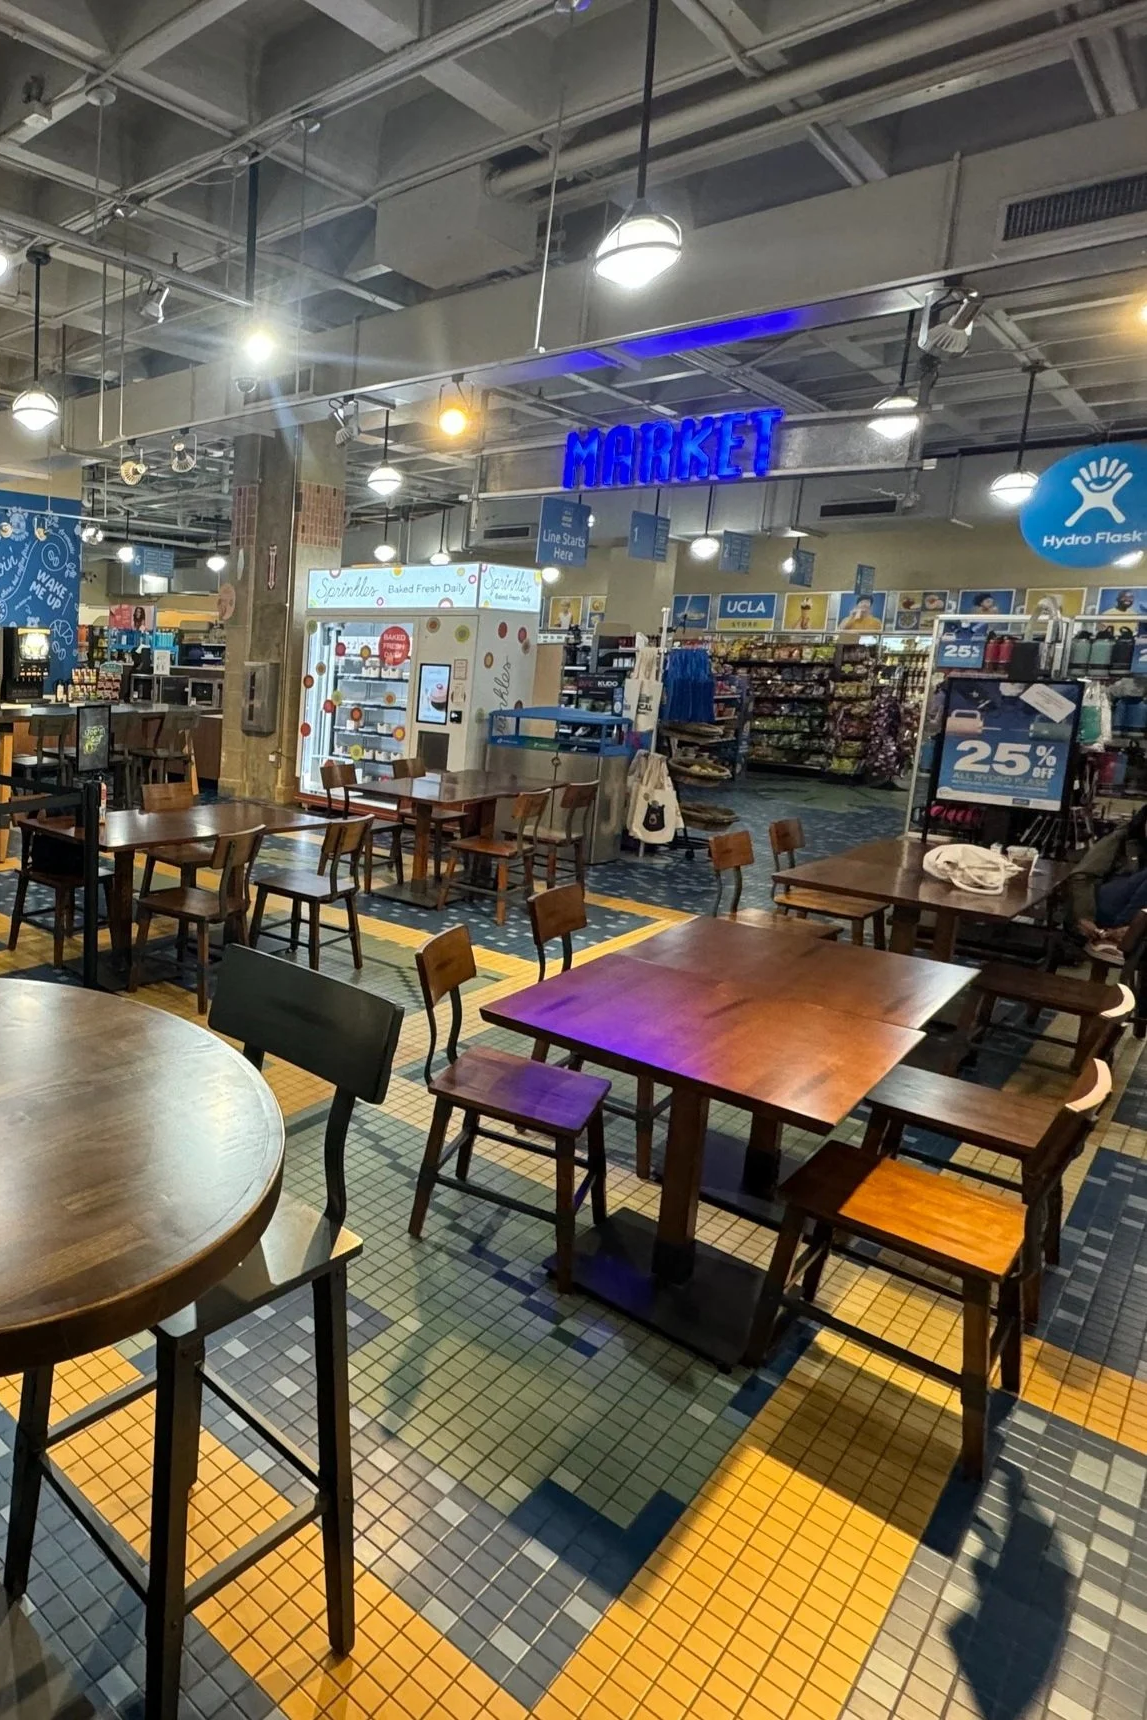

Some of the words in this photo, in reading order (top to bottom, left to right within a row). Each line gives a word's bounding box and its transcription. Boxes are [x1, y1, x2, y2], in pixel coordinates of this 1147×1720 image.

[562, 407, 785, 490] MARKET
[543, 529, 561, 543] Line
[562, 532, 586, 549] Starts
[1043, 533, 1092, 548] Hydro
[1095, 530, 1143, 545] Flask
[553, 547, 574, 561] Here
[36, 569, 69, 600] WAKE
[316, 576, 380, 604] Sprinkles
[388, 585, 414, 594] Baked
[416, 584, 441, 593] Fresh
[445, 583, 467, 595] Daily
[484, 566, 532, 596] Sprinkles
[29, 581, 45, 600] ME
[47, 592, 63, 611] UP
[727, 600, 767, 615] UCLA
[382, 642, 406, 650] FRESH
[383, 633, 406, 642] BAKED
[953, 772, 973, 780] ALL
[973, 774, 1011, 784] HYDRO
[1014, 777, 1048, 787] FLASK
[1032, 767, 1056, 779] OFF
